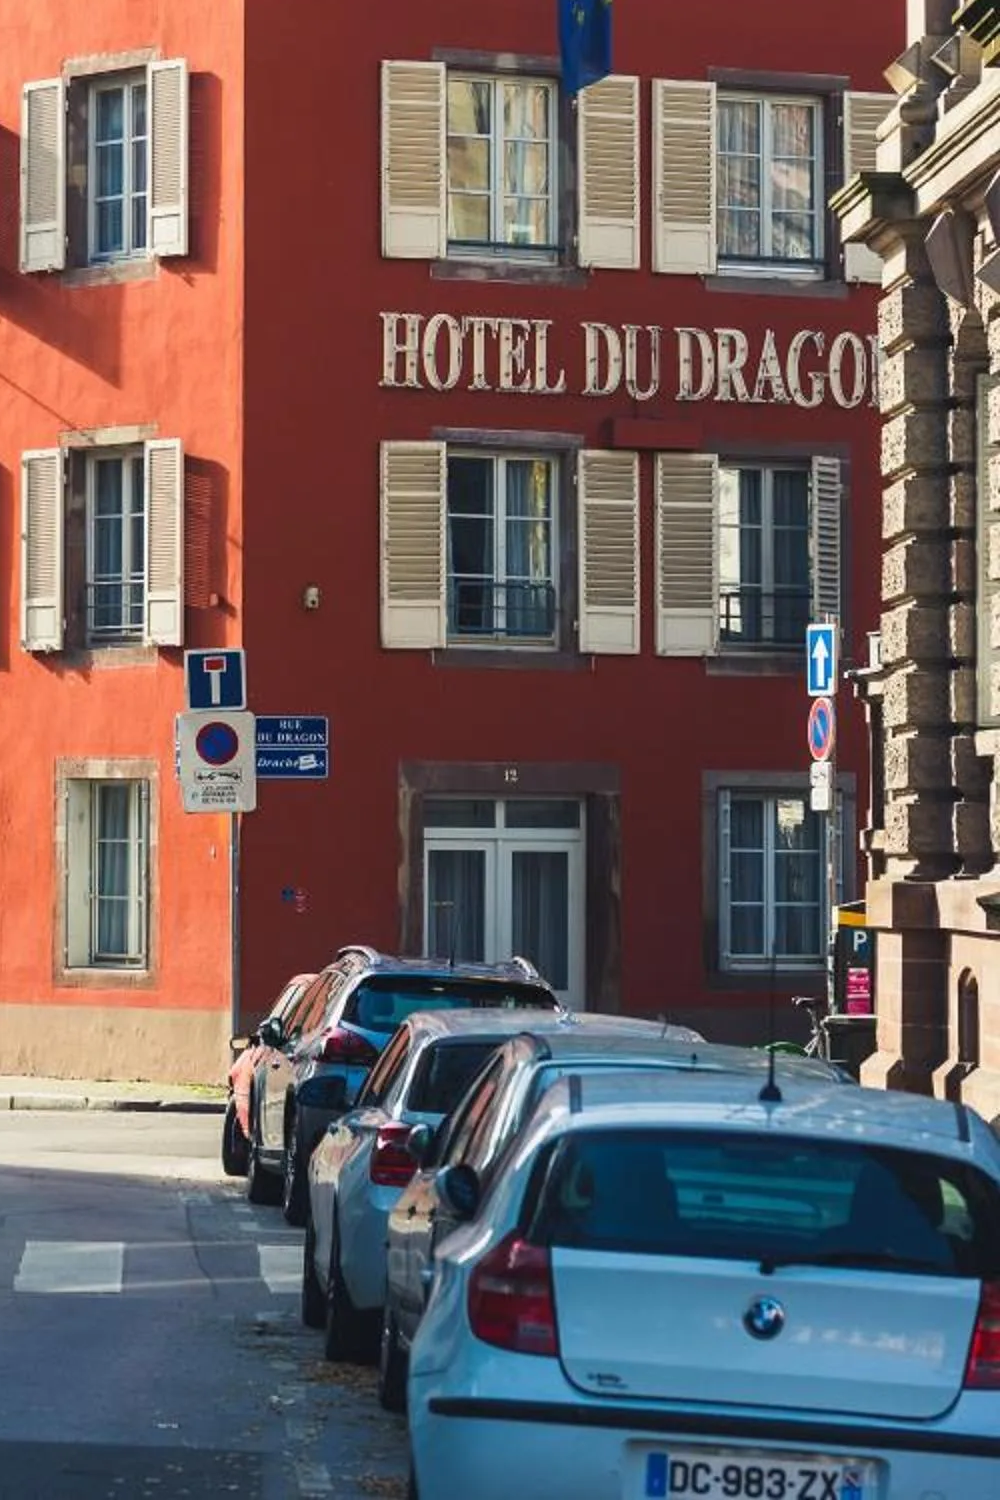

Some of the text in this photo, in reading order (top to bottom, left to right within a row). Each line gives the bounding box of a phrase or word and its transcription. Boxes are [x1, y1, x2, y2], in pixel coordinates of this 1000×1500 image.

[377, 311, 567, 394] HOTEL
[580, 321, 663, 401] DU
[279, 719, 303, 730] RUE
[257, 732, 325, 743] DU DRAGON
[853, 930, 868, 953] P
[669, 1460, 839, 1500] DC-983-ZX
